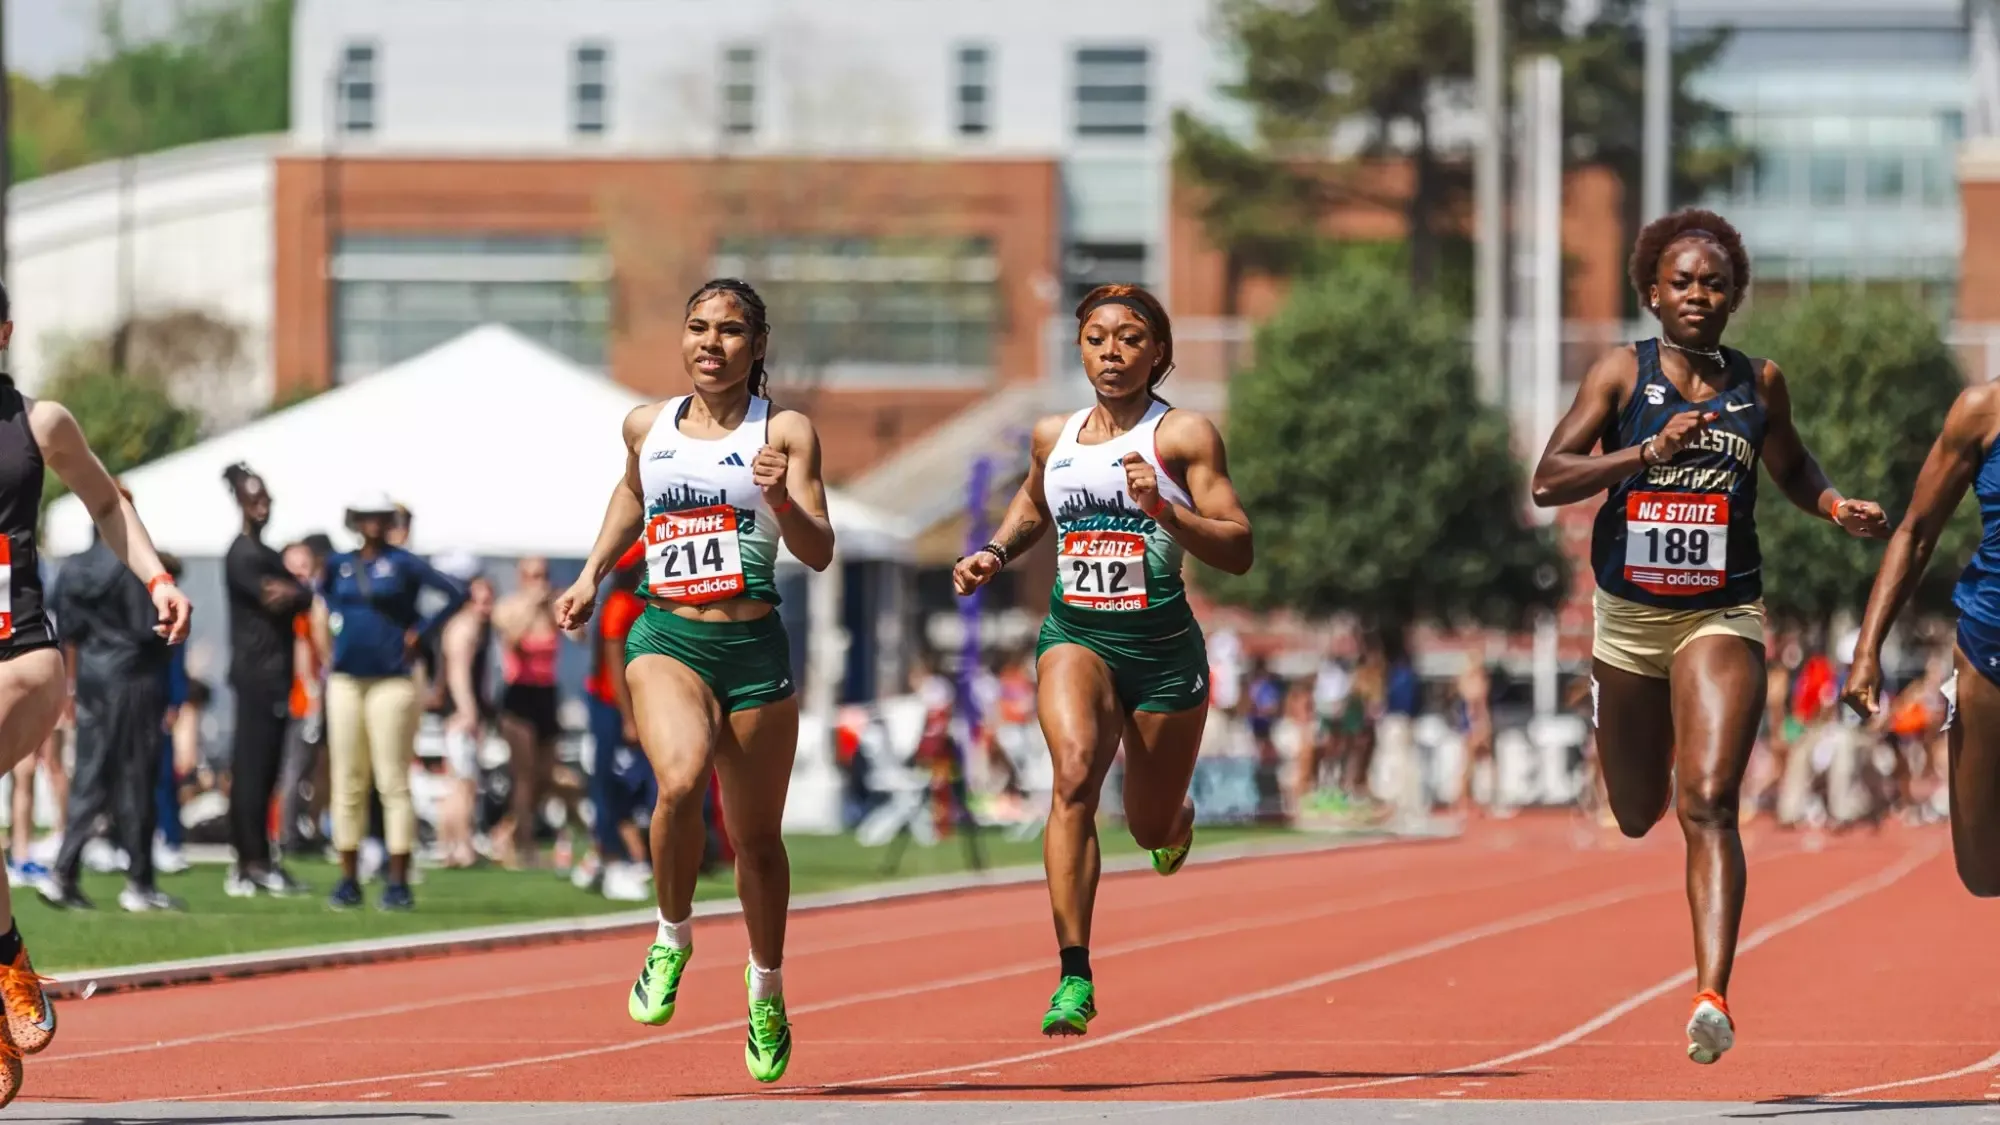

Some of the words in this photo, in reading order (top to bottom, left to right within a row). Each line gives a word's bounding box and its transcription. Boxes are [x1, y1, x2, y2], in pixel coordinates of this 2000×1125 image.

[1648, 465, 1738, 492] SOUTHERN
[1638, 502, 1662, 520] NC
[1665, 503, 1717, 522] STATE
[656, 522, 674, 541] NC
[678, 514, 724, 535] STATE
[661, 538, 724, 578] 214
[1068, 541, 1088, 555] NC
[1087, 540, 1135, 556] STATE
[1645, 528, 1709, 565] 189
[688, 579, 737, 595] adidas
[1073, 560, 1128, 593] 212
[1667, 572, 1719, 586] adidas
[1095, 599, 1141, 610] adidas
